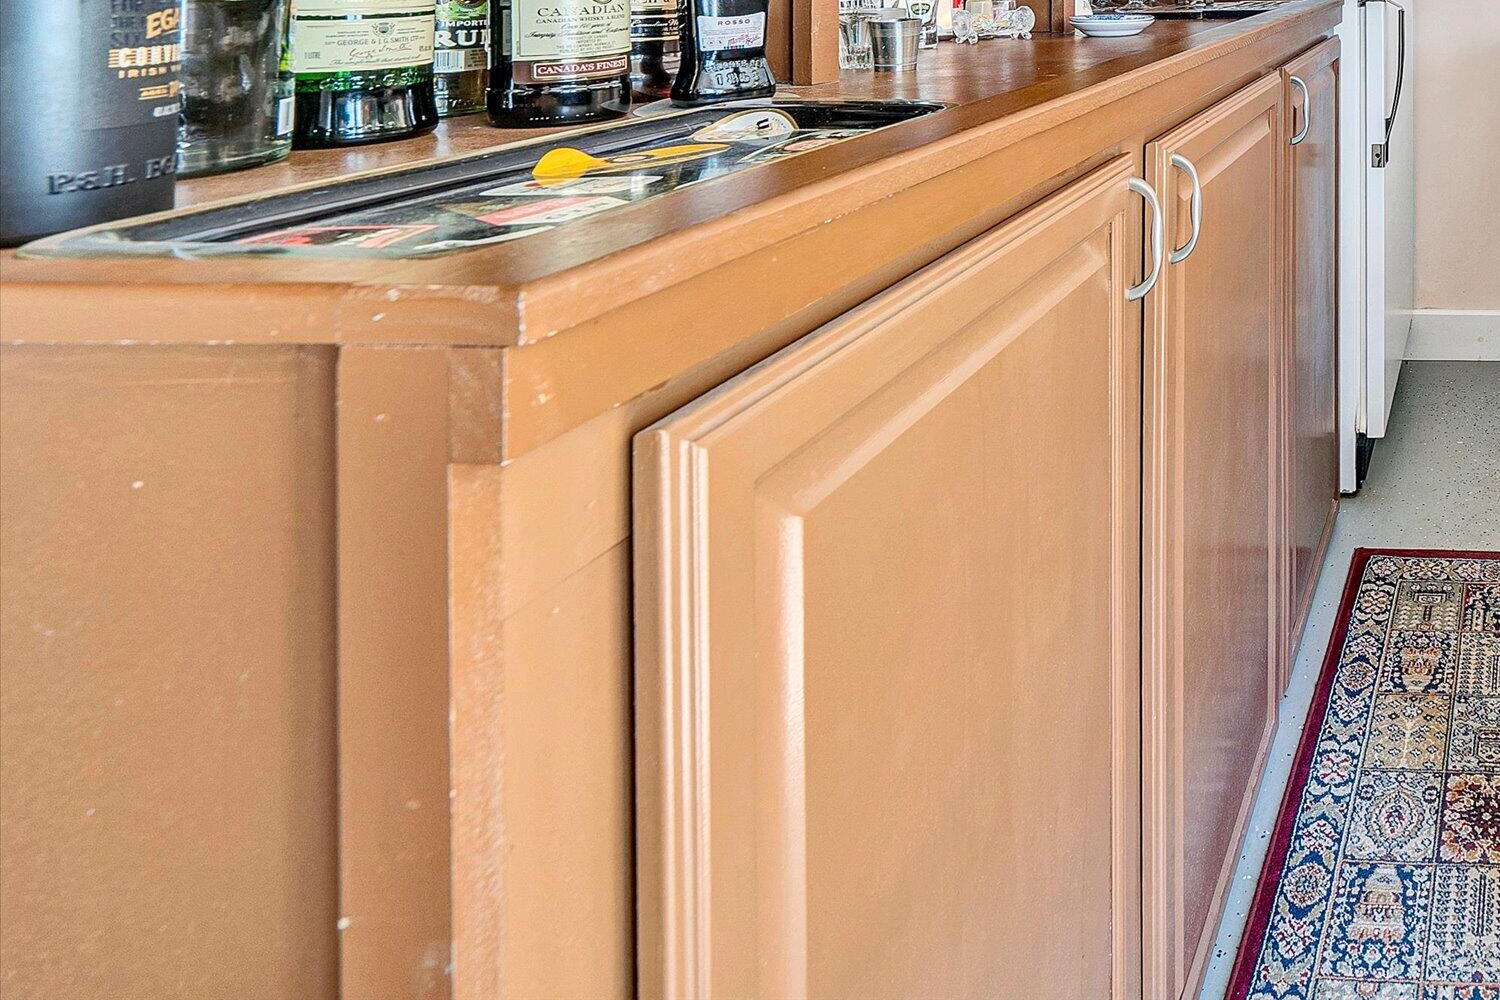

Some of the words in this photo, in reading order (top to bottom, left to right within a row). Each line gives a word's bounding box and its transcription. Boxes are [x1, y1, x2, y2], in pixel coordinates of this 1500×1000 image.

[537, 3, 625, 17] CANADIAN
[537, 63, 595, 75] CANADA'S
[596, 60, 625, 70] FINEST
